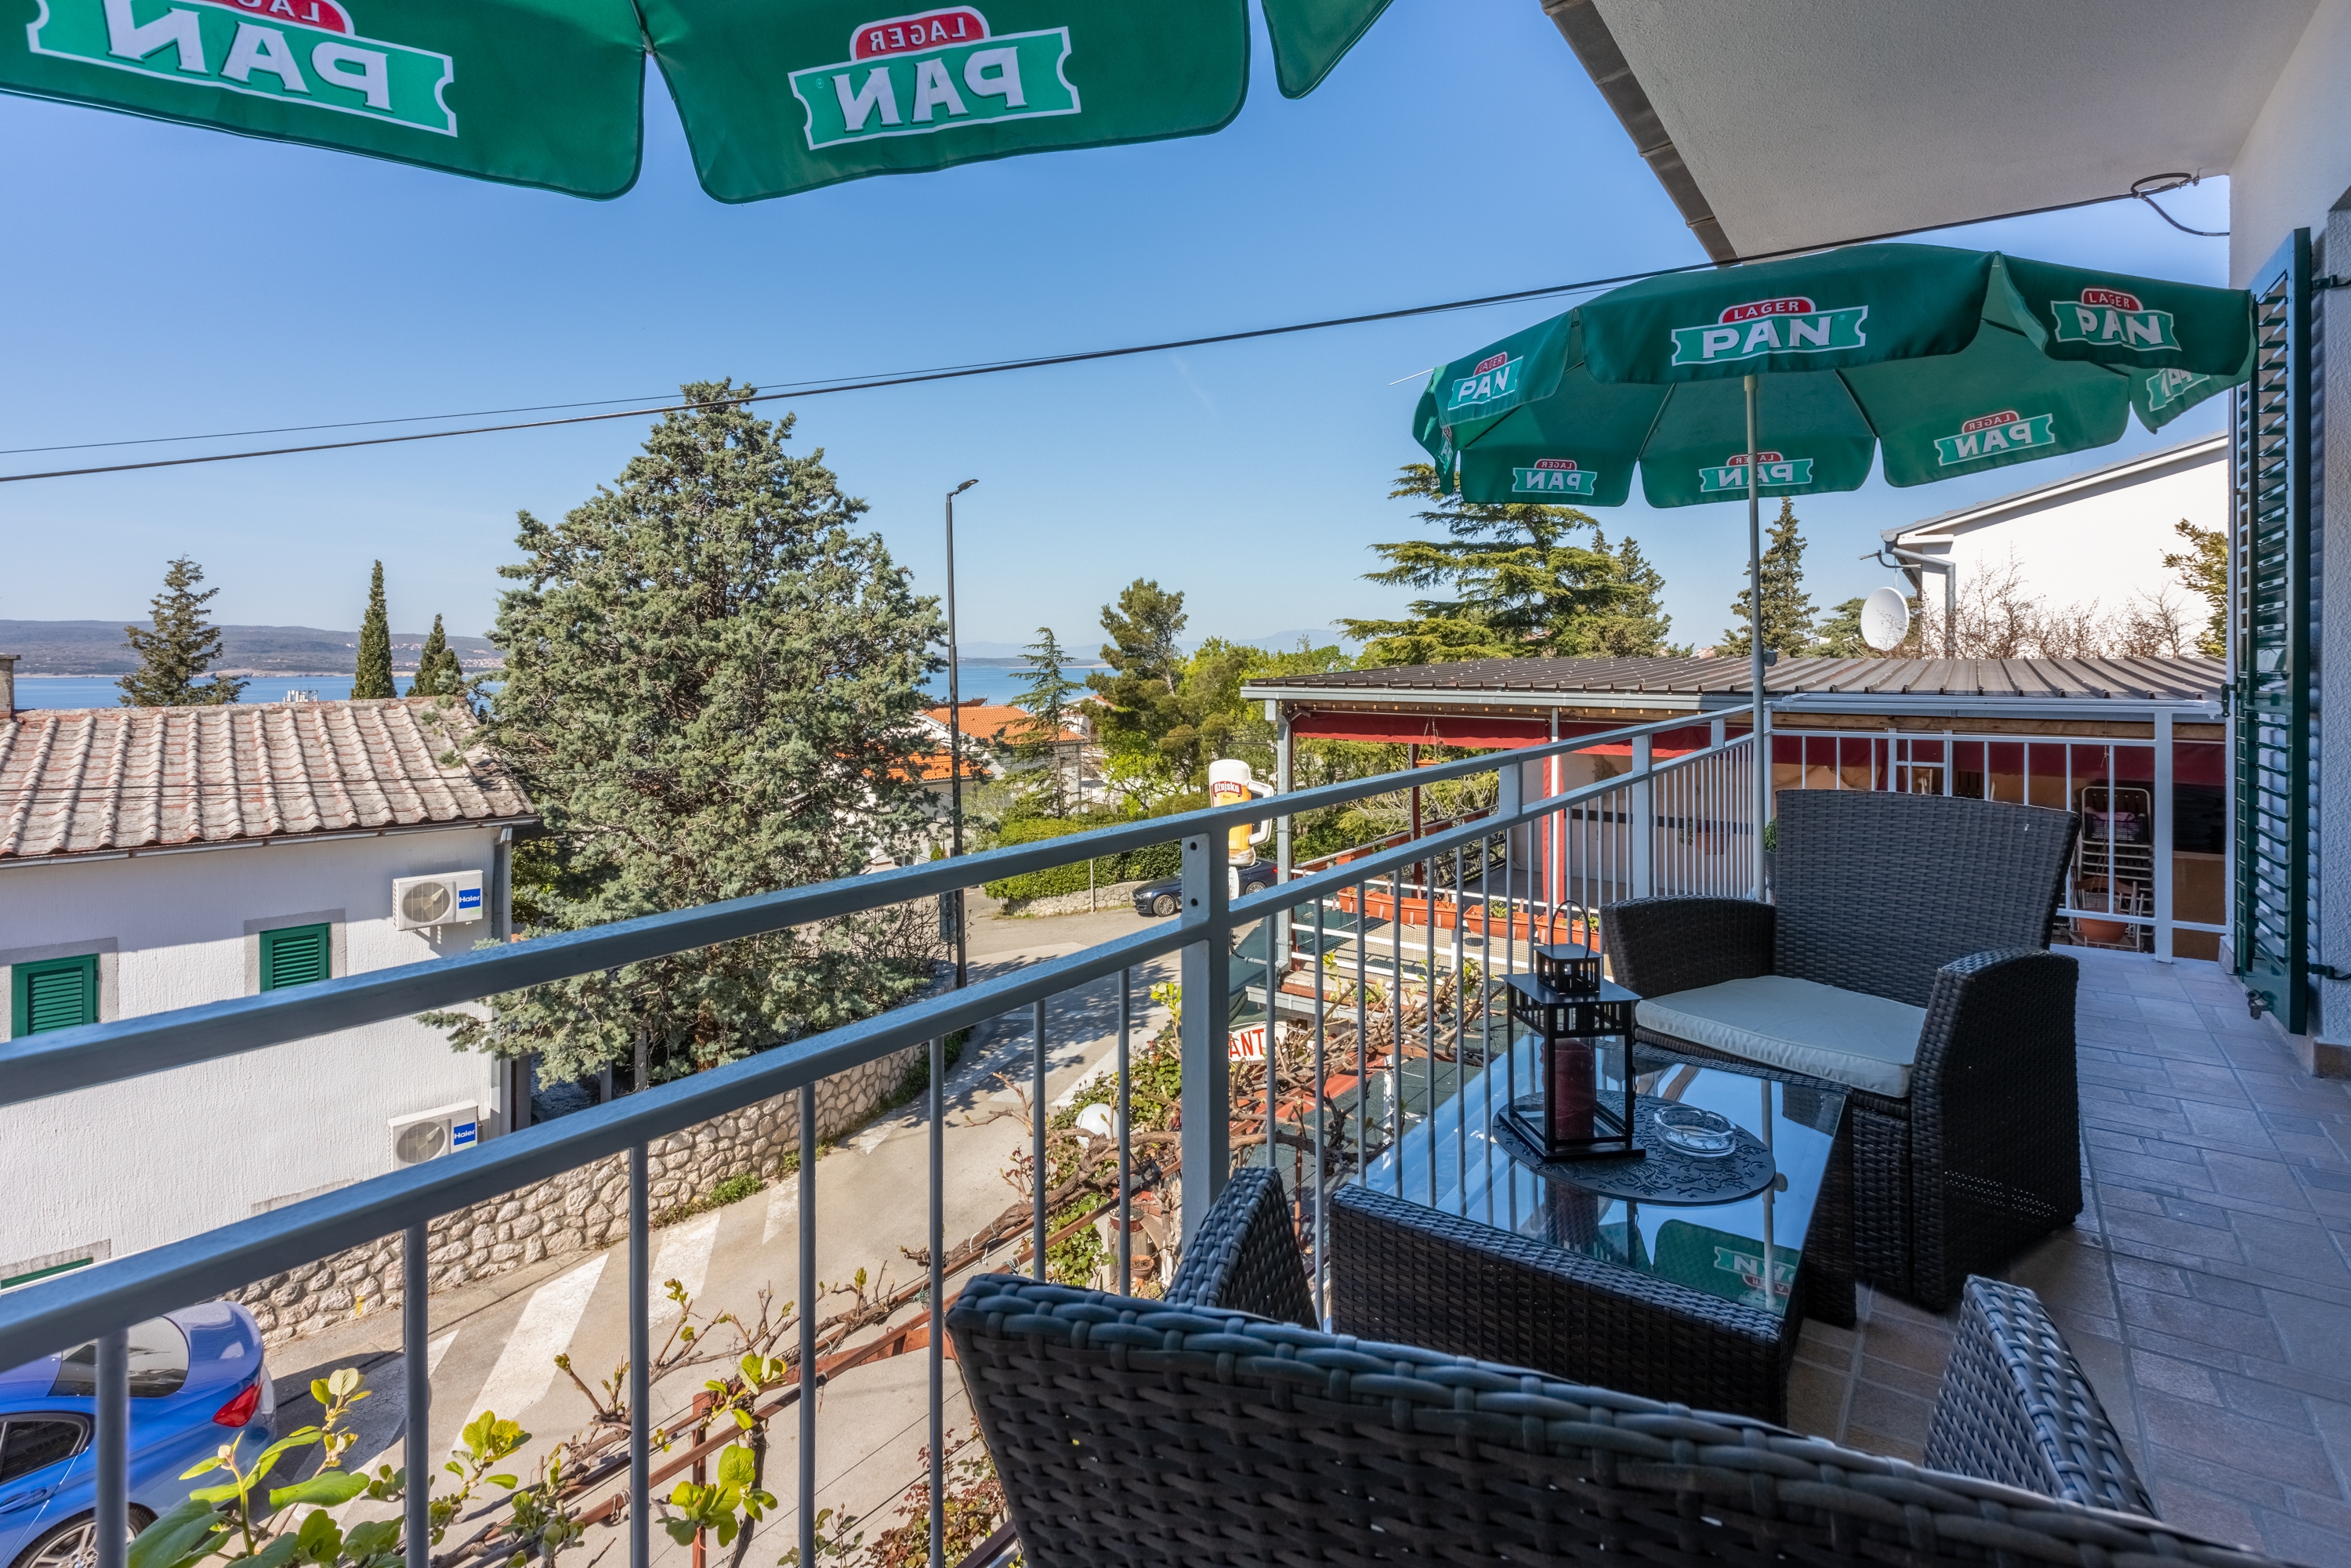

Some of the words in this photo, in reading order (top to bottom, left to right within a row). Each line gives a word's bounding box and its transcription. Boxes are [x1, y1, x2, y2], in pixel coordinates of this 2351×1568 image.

[2089, 292, 2131, 309] LAGER
[1734, 301, 1800, 320] LAGER
[2074, 306, 2165, 346] PAN
[1702, 316, 1834, 359] PAN
[1479, 356, 1503, 373] LAGER
[1458, 365, 1511, 403] PAN
[454, 1129, 476, 1139] Haier
